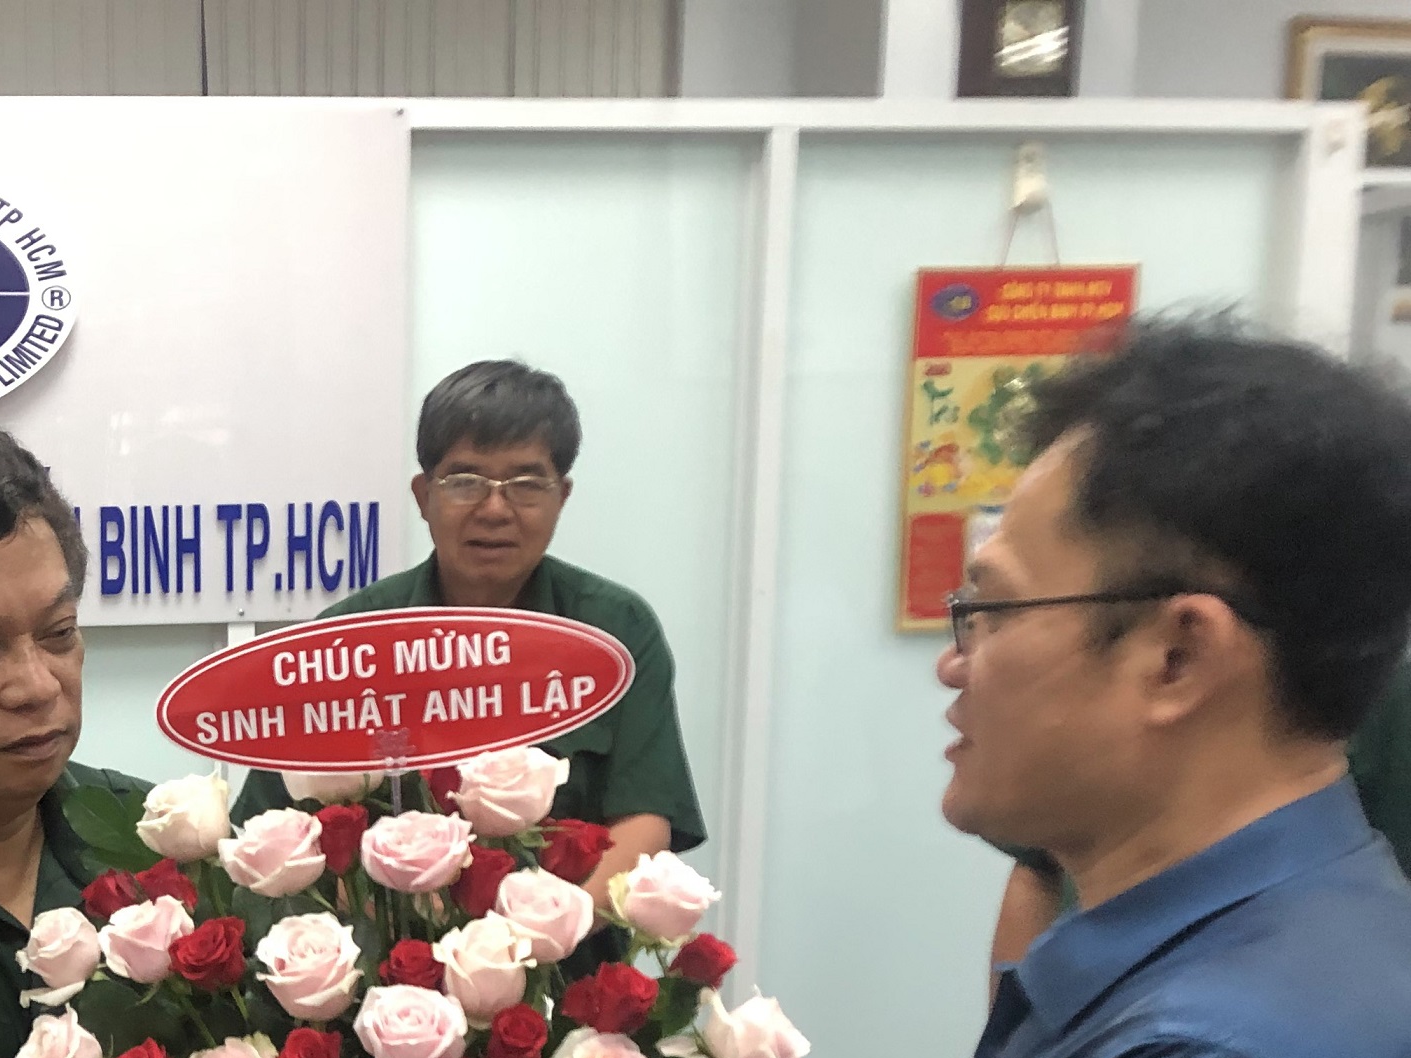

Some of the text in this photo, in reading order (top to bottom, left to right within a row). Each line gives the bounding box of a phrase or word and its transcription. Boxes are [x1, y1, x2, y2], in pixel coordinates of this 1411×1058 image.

[15, 225, 67, 283] HCM
[99, 503, 202, 596] BINH
[216, 499, 381, 593] TP.HCM
[273, 626, 513, 688] CHÚC MỪNG
[195, 669, 599, 746] SINH NHẬT ANH LẬP
